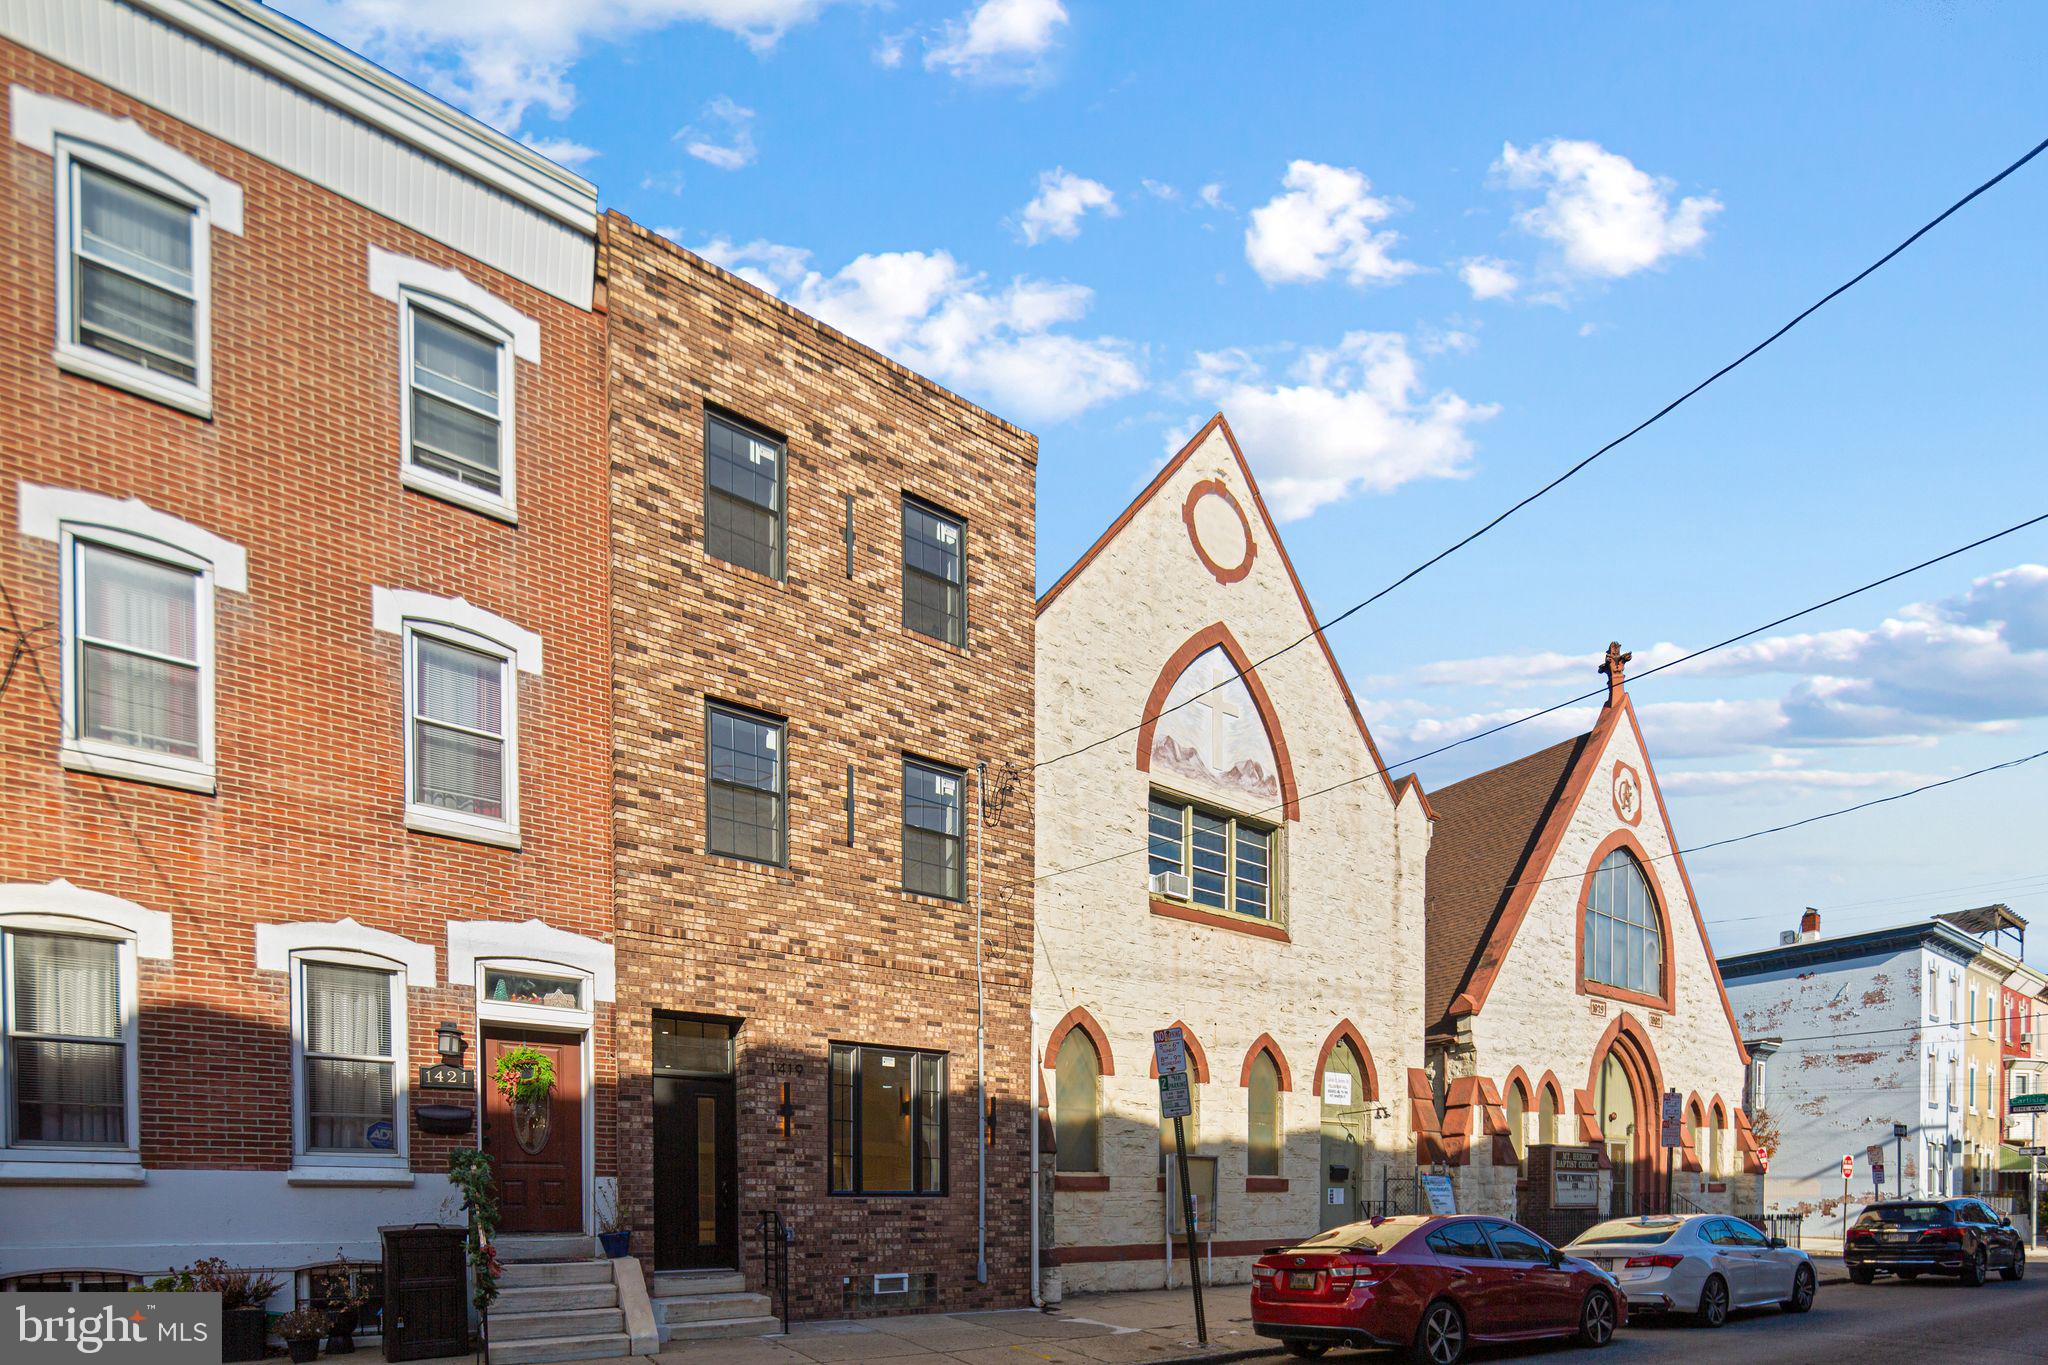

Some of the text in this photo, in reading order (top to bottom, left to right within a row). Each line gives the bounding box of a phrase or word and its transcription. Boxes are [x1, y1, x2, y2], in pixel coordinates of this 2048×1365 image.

[1155, 1031, 1165, 1042] NO
[425, 1070, 468, 1084] 1421
[1556, 1159, 1599, 1169] BAPTIST CHURCH
